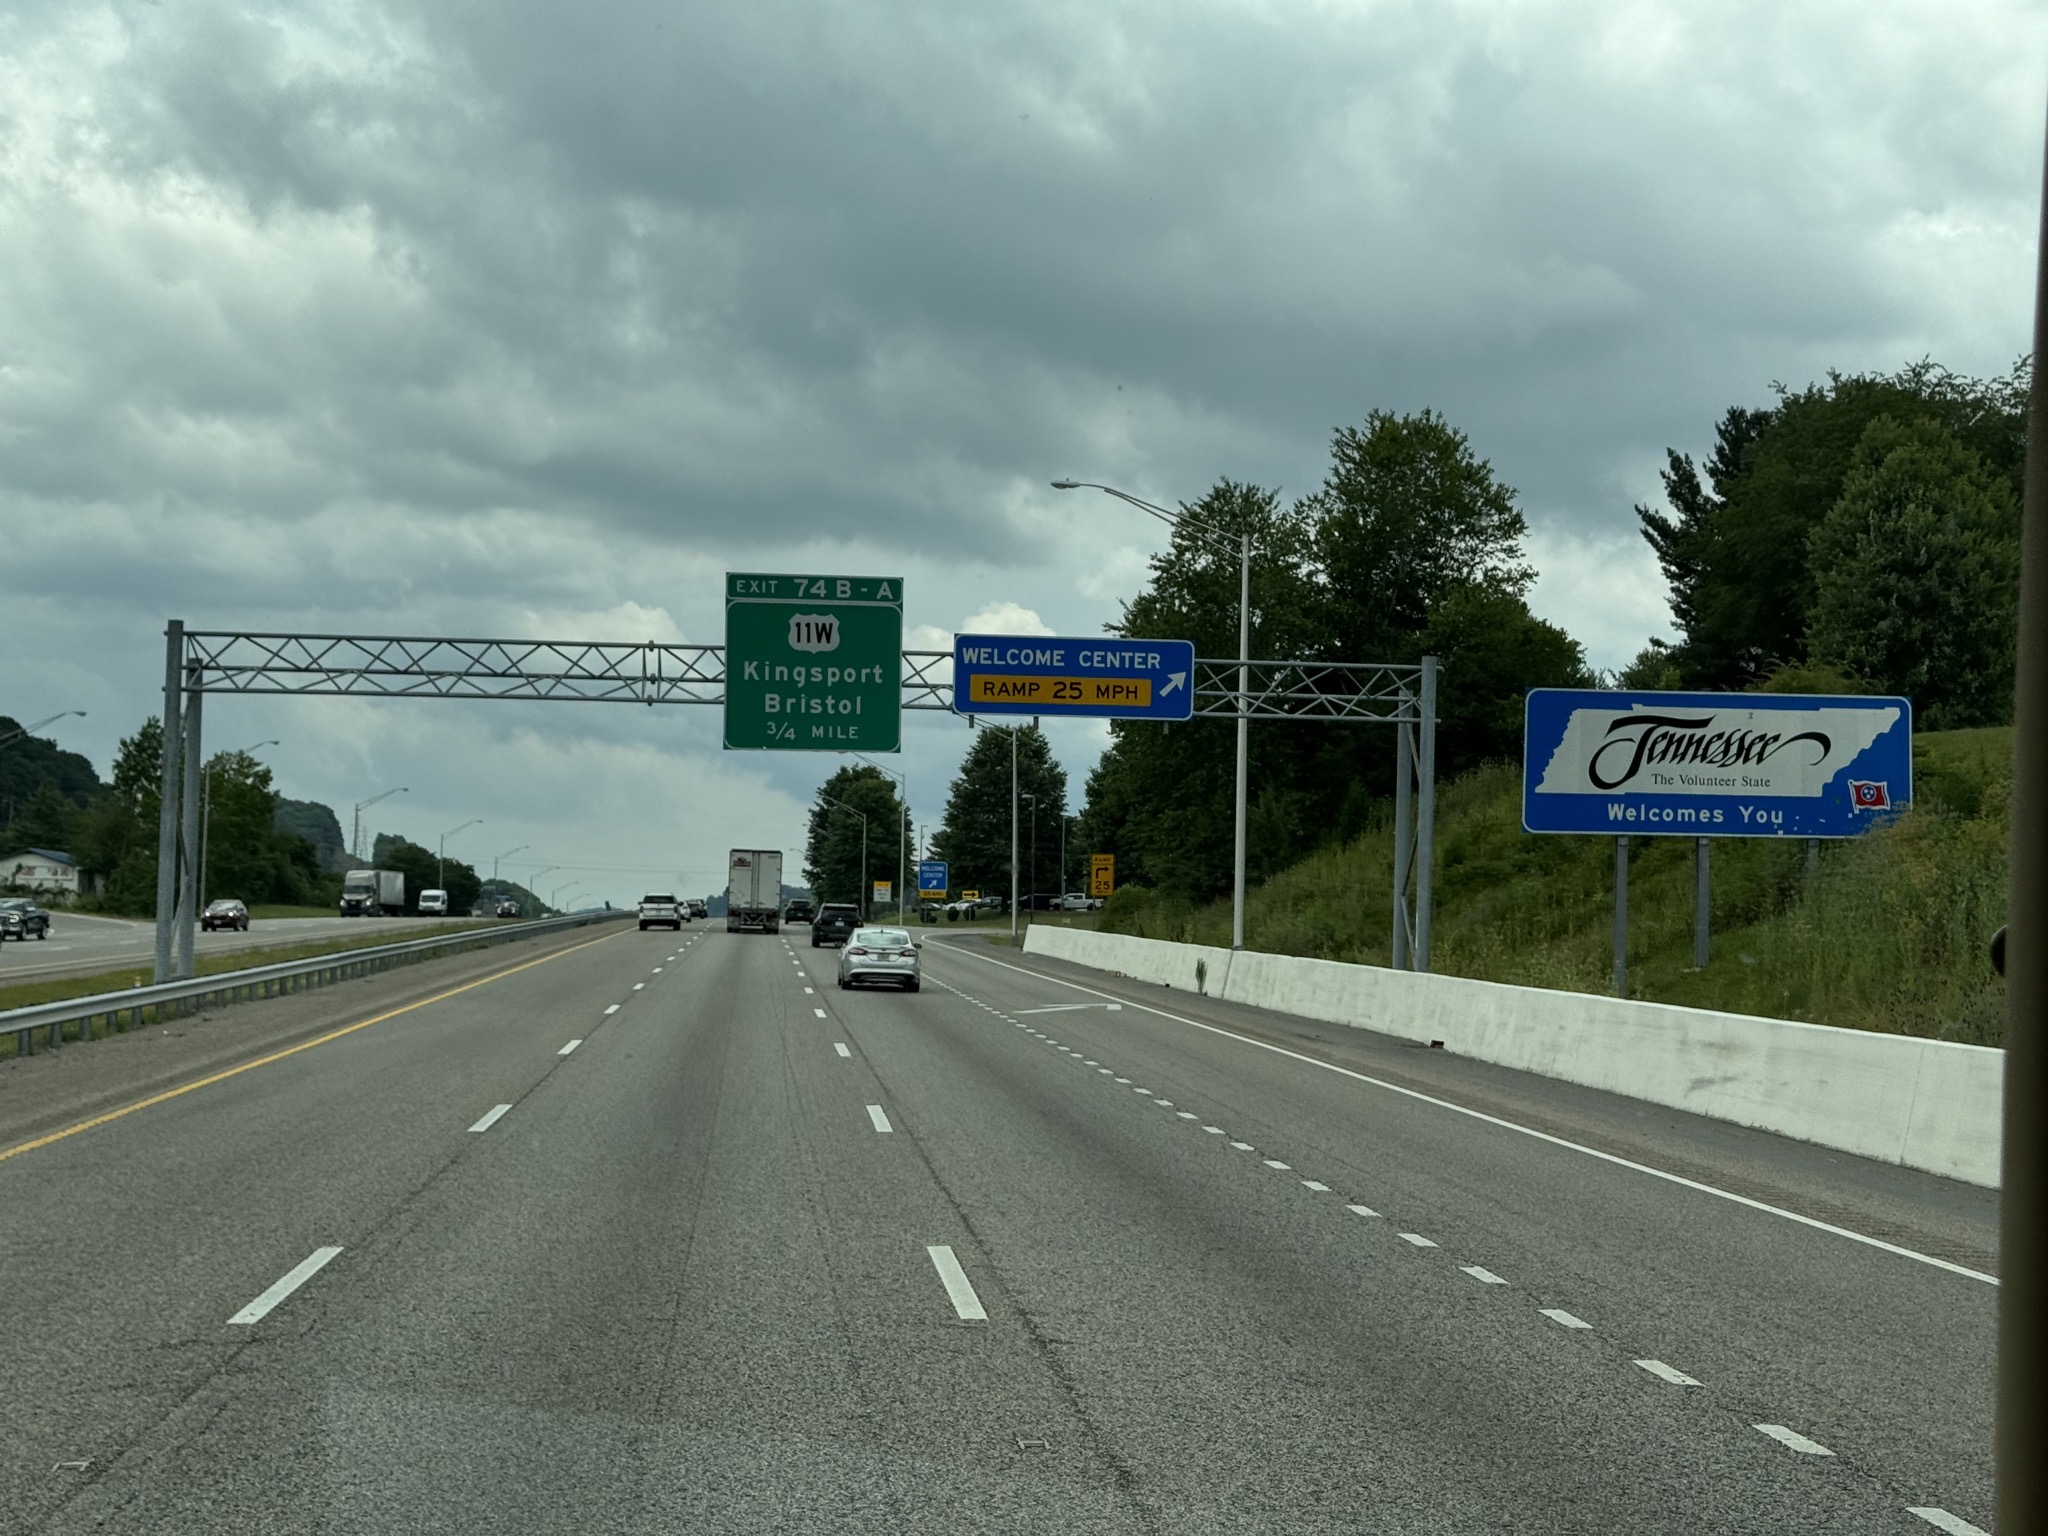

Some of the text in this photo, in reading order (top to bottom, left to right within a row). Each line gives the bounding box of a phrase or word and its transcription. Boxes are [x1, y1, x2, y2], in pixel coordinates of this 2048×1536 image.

[736, 580, 778, 594] EXIT
[794, 578, 827, 598] 74
[795, 622, 834, 644] 11W
[962, 647, 1160, 669] WELCOME CENTER
[743, 661, 884, 688] Kingsport
[983, 681, 1139, 700] RAMP 25 MPH
[765, 693, 862, 715] Bristol
[766, 722, 859, 740] 3/4 MILE
[1588, 714, 1832, 790] Tennessee
[1651, 773, 1771, 788] The Volunteer State
[1607, 803, 1783, 824] Welcomes You
[1095, 880, 1110, 890] 25
